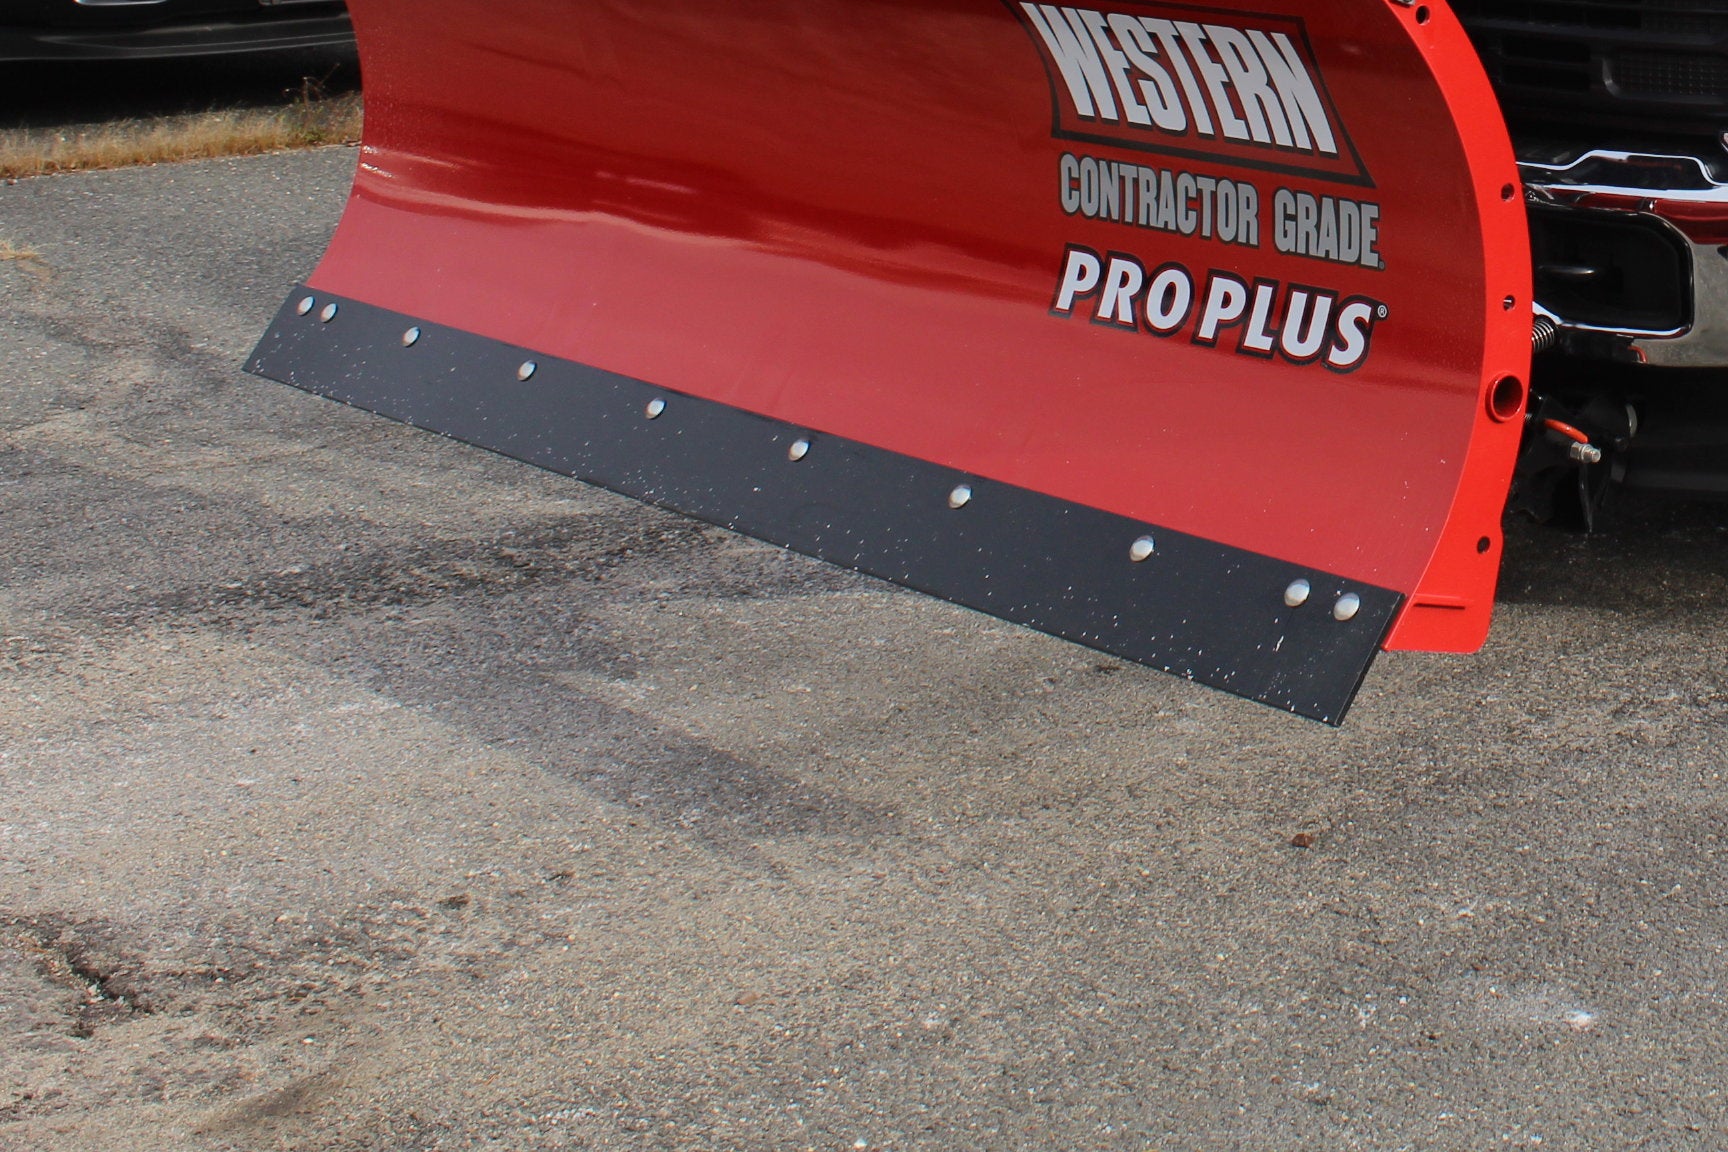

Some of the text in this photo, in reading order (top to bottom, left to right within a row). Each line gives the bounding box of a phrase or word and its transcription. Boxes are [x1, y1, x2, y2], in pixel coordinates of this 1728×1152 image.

[1019, 1, 1338, 154] WESTERN
[1060, 153, 1380, 269] CONTRACTOR GRADE
[1055, 250, 1191, 330] PRO
